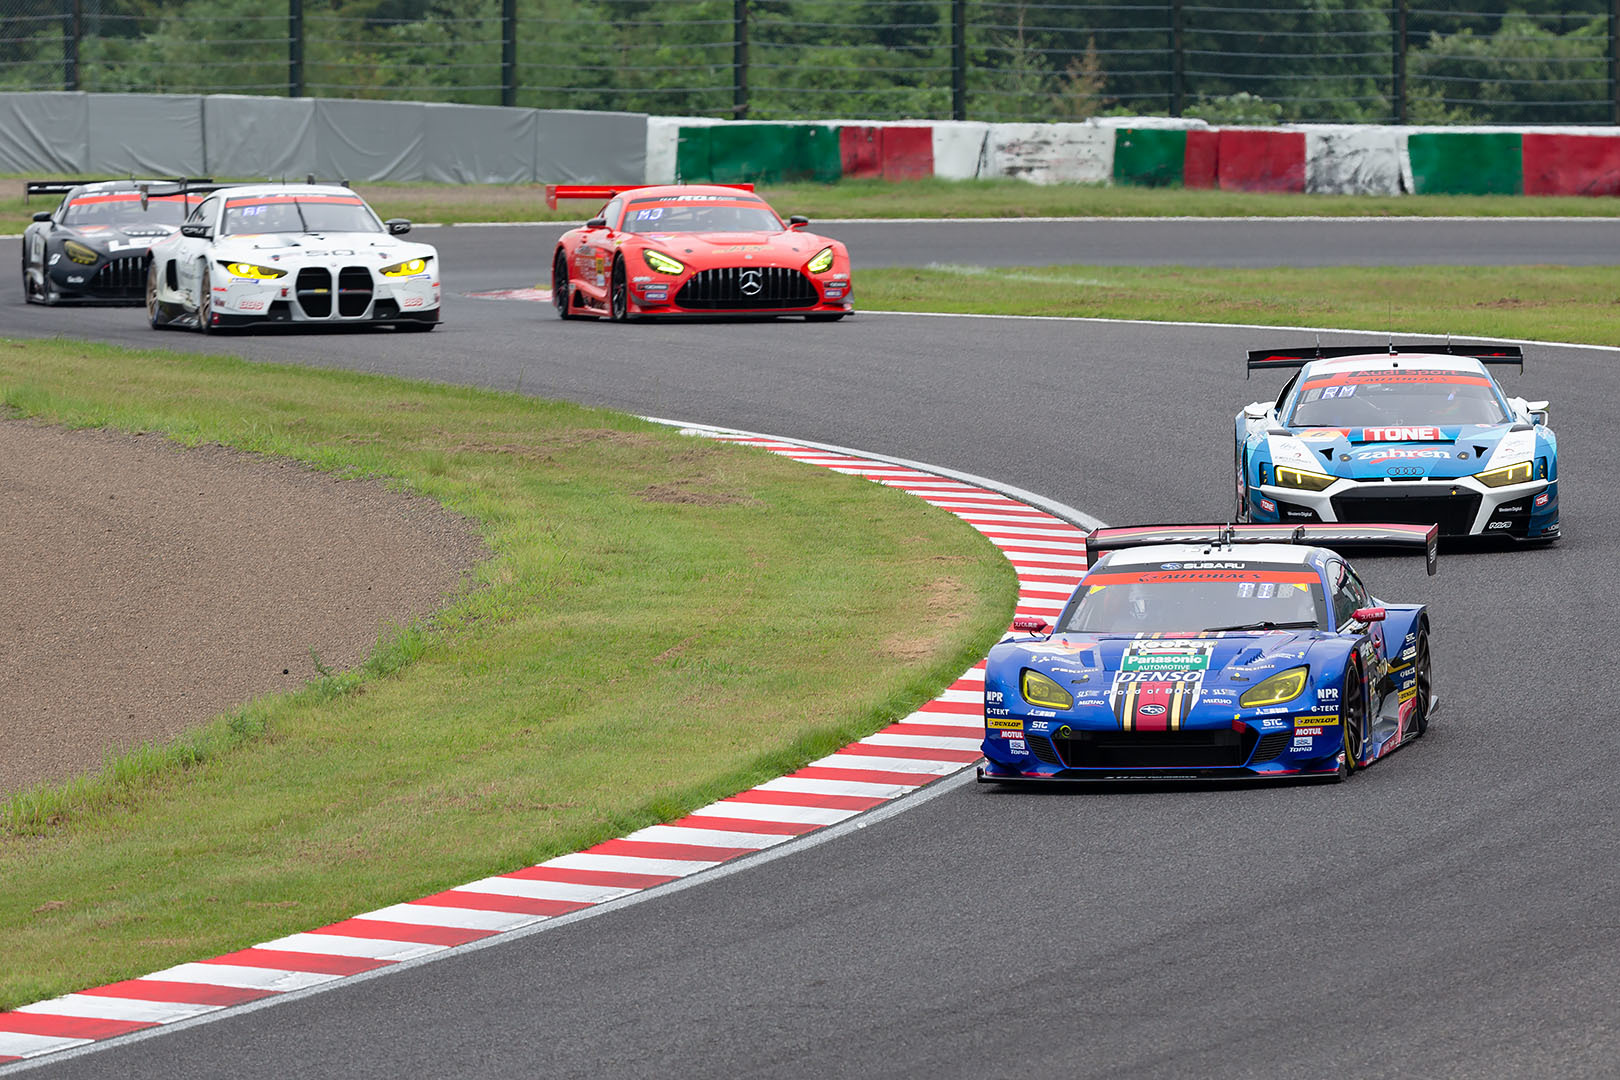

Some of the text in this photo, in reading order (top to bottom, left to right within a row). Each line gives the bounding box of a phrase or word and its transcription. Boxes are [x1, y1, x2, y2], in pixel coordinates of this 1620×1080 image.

[1369, 428, 1435, 441] TONE
[1183, 562, 1246, 570] SUBARU
[1128, 655, 1203, 664] Panasonic
[1117, 671, 1203, 682] DENSO
[1317, 688, 1339, 699] NPR
[1311, 704, 1339, 712] G-TEKT
[1262, 718, 1283, 726] STC
